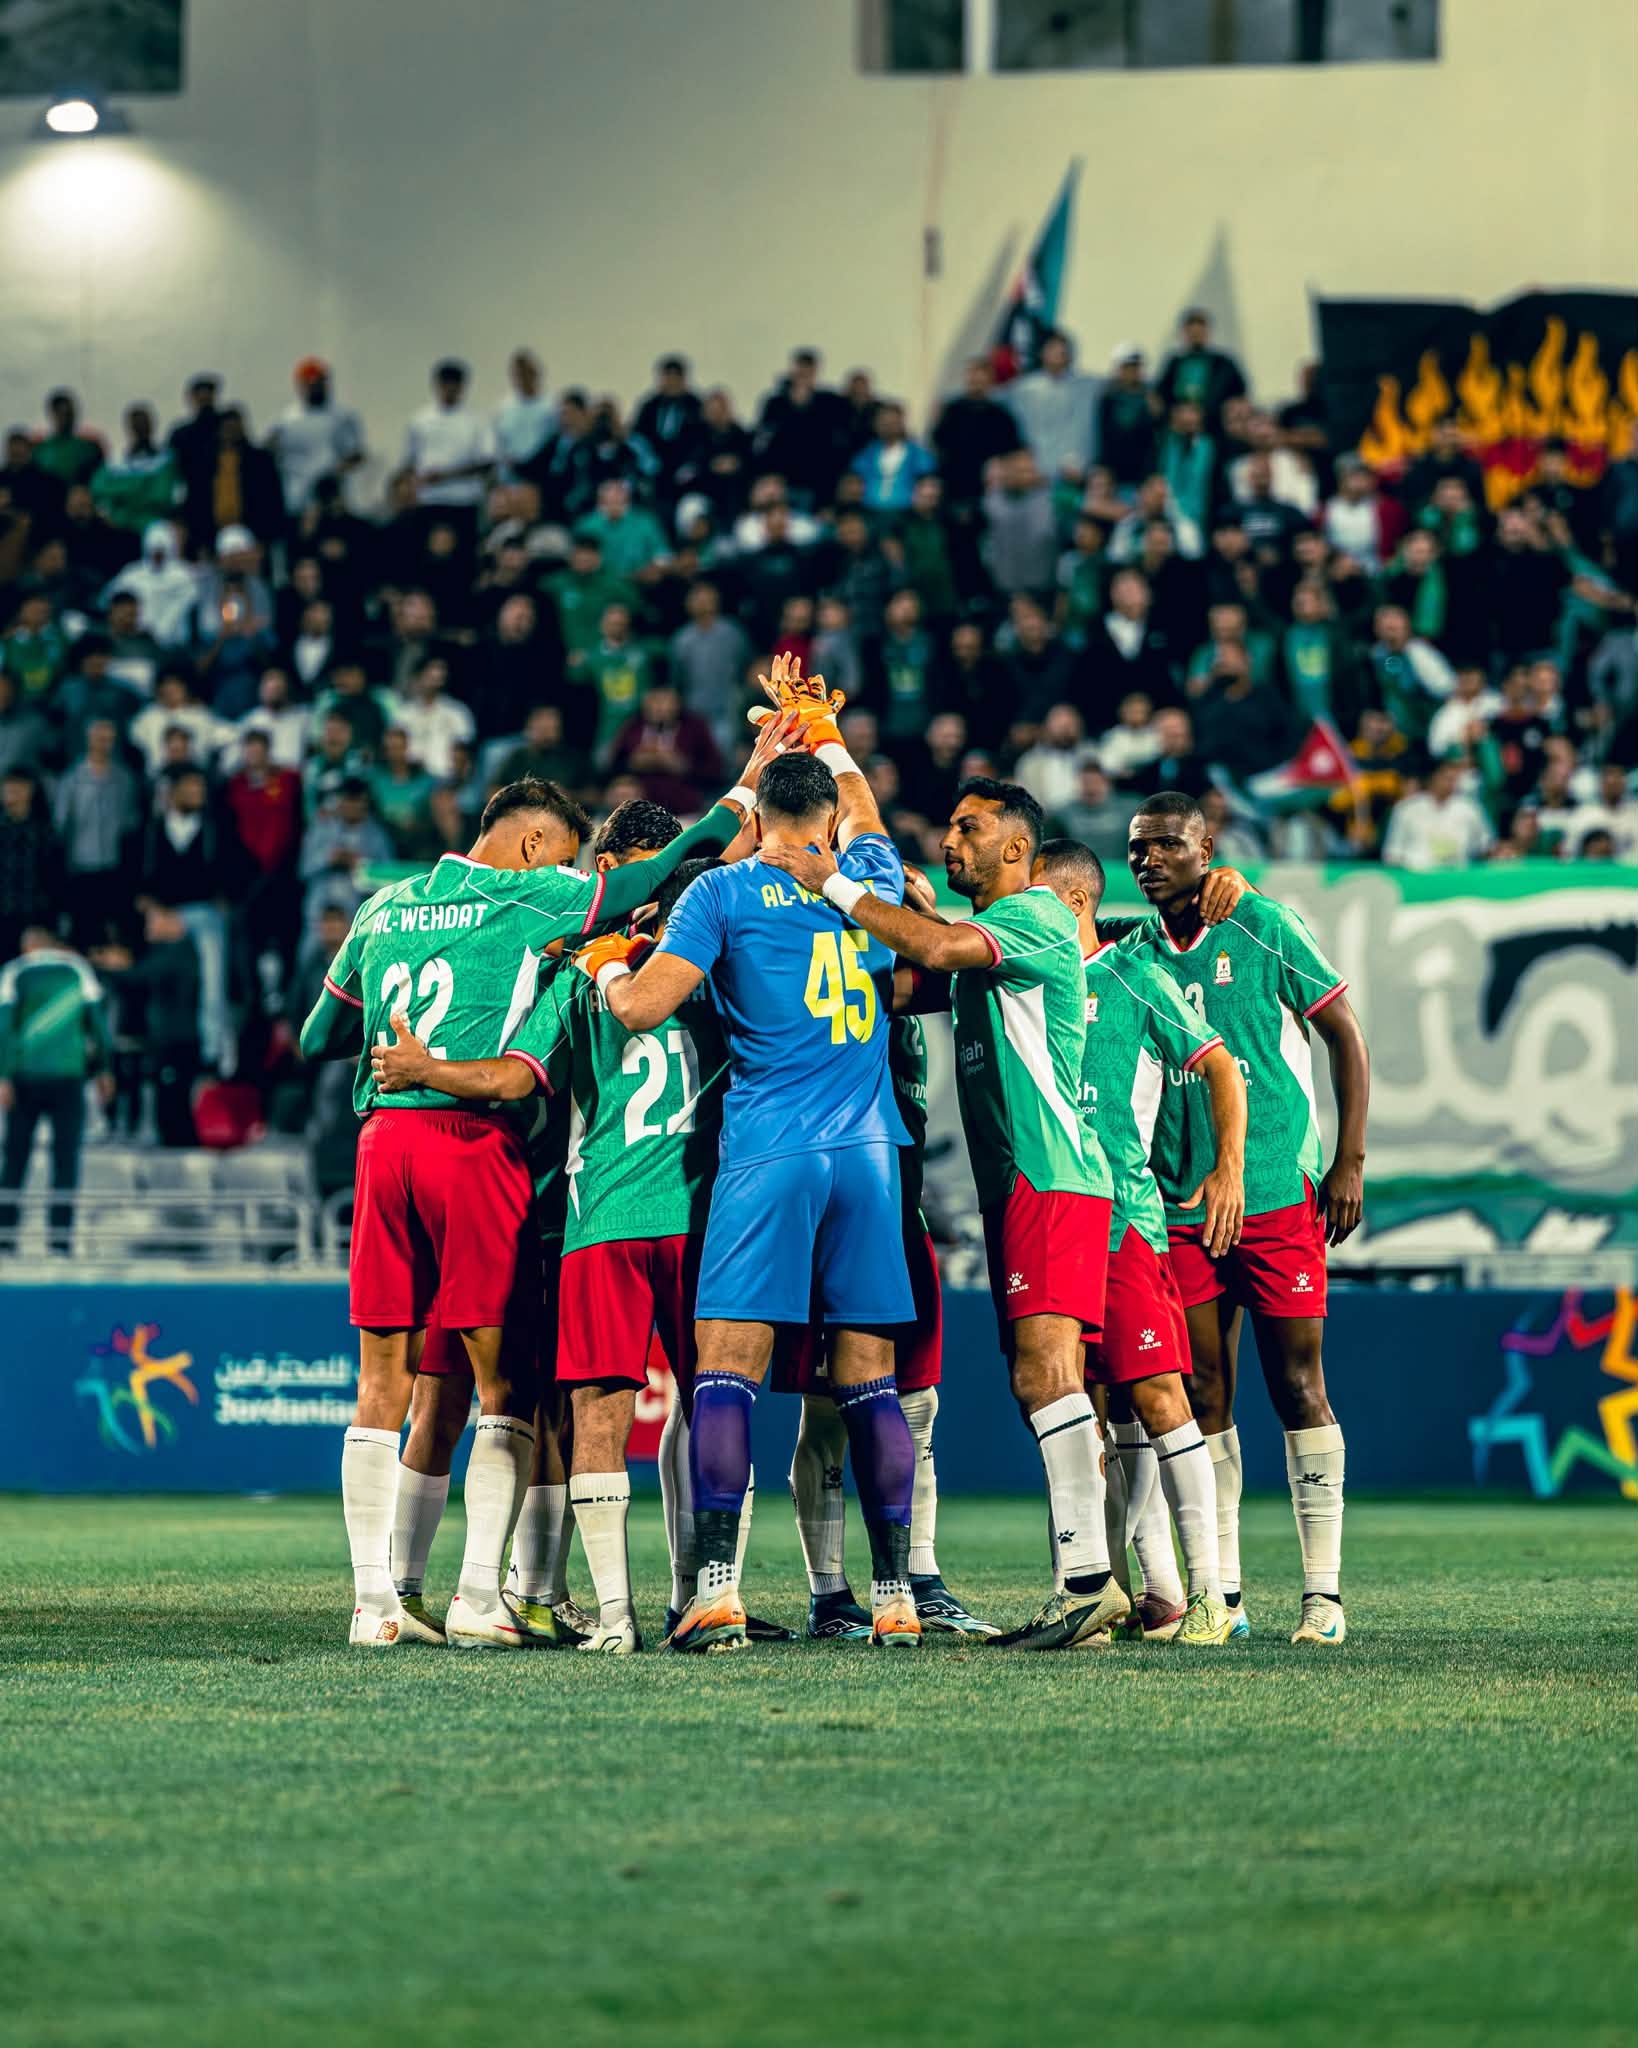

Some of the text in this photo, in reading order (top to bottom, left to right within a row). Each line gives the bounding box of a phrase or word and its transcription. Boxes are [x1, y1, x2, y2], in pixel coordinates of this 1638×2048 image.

[372, 903, 489, 934] AL-WEHDAT
[804, 929, 876, 1045] 45
[1007, 1284, 1029, 1295] KELME
[1138, 1341, 1162, 1351] KELME
